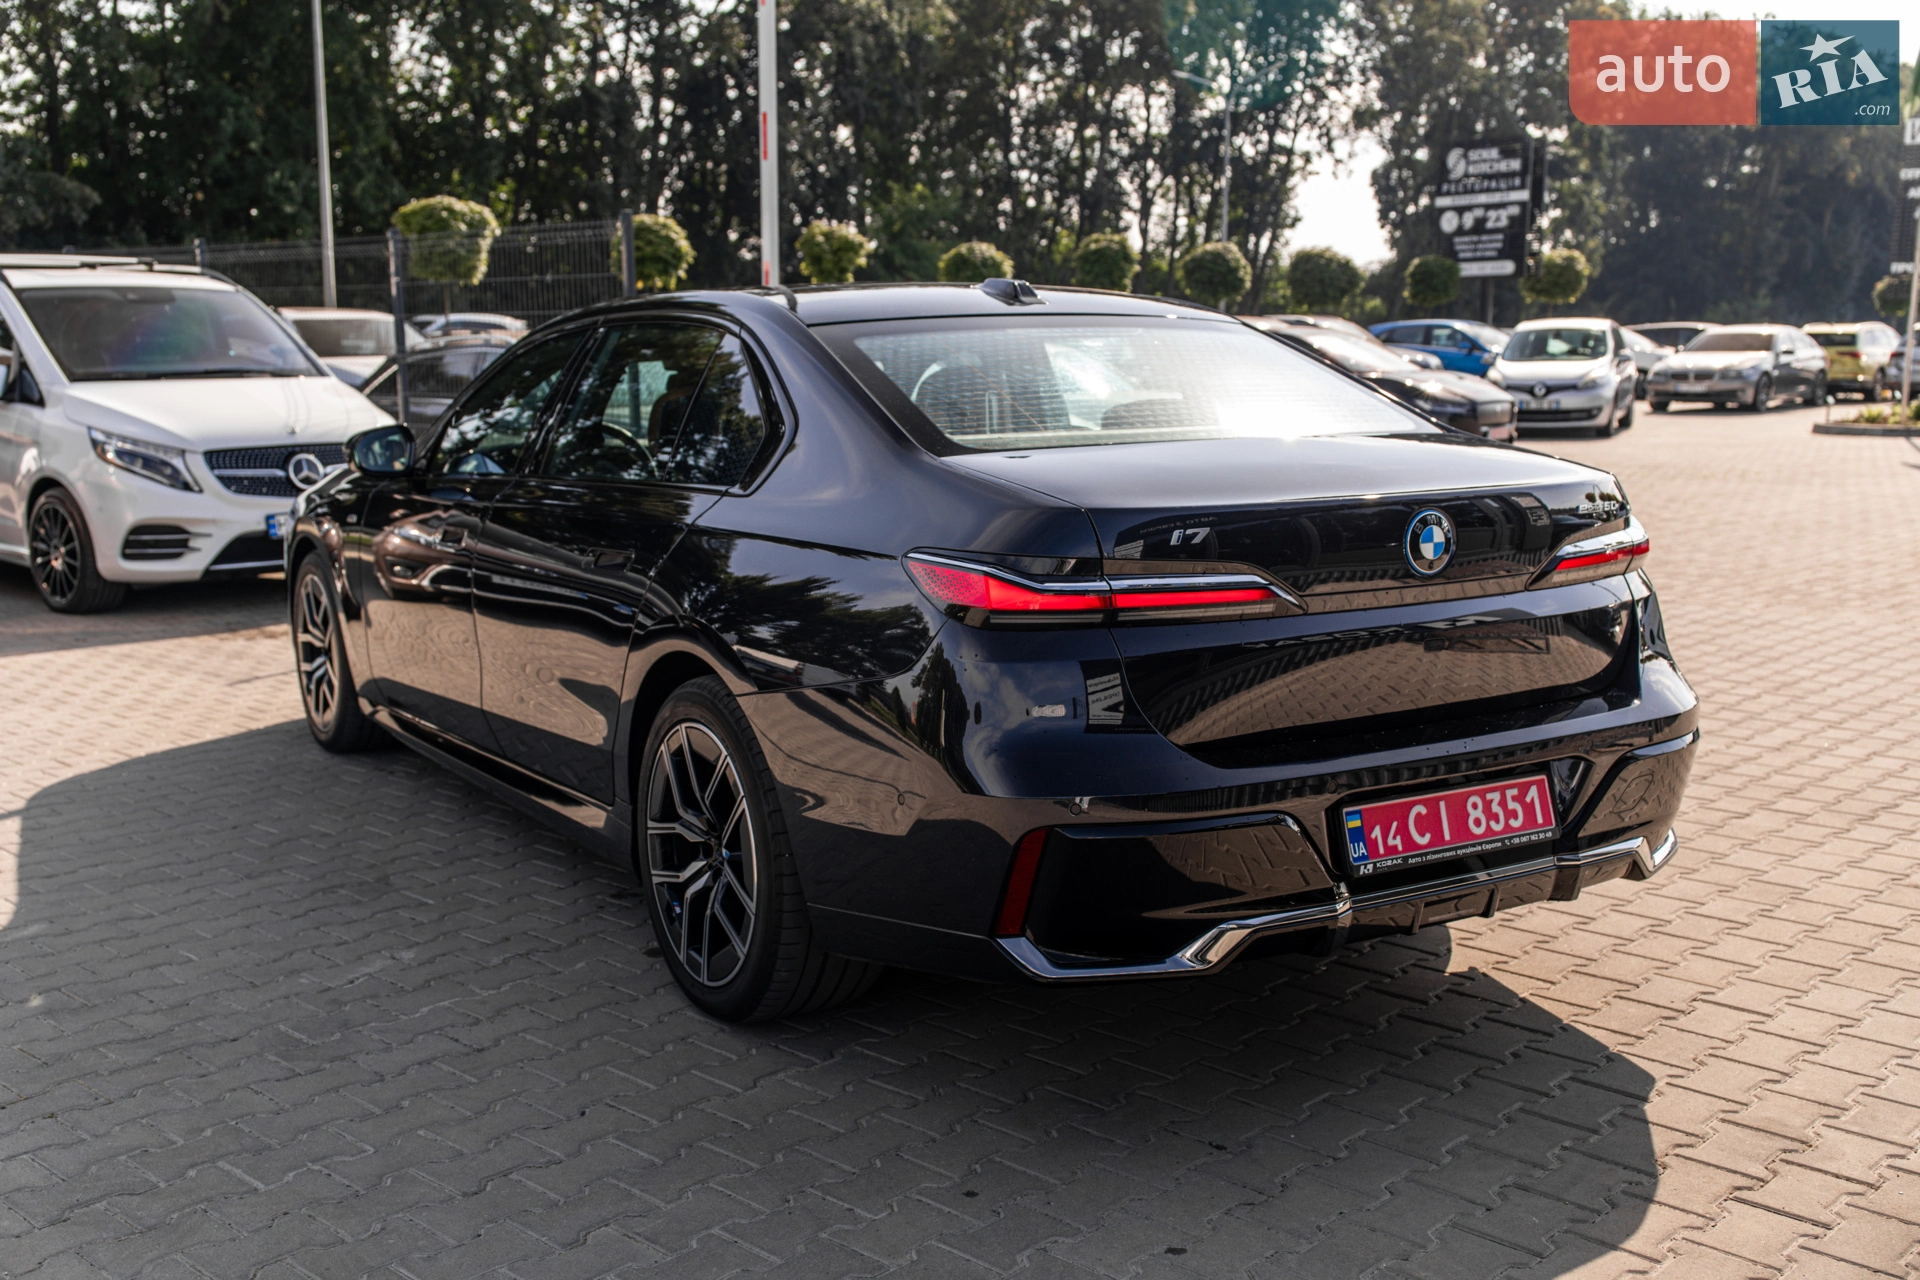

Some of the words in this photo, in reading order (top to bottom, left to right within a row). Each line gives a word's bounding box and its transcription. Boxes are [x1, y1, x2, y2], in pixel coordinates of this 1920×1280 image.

[1414, 514, 1452, 538] BMW
[1170, 527, 1211, 546] i7
[1371, 821, 1402, 854] 14
[1466, 784, 1544, 835] 8351
[1350, 841, 1367, 858] UA
[1426, 851, 1456, 861] лізингових
[1456, 845, 1481, 855] аукціонів
[1482, 841, 1502, 850] Європи
[1376, 858, 1403, 868] KOZAK
